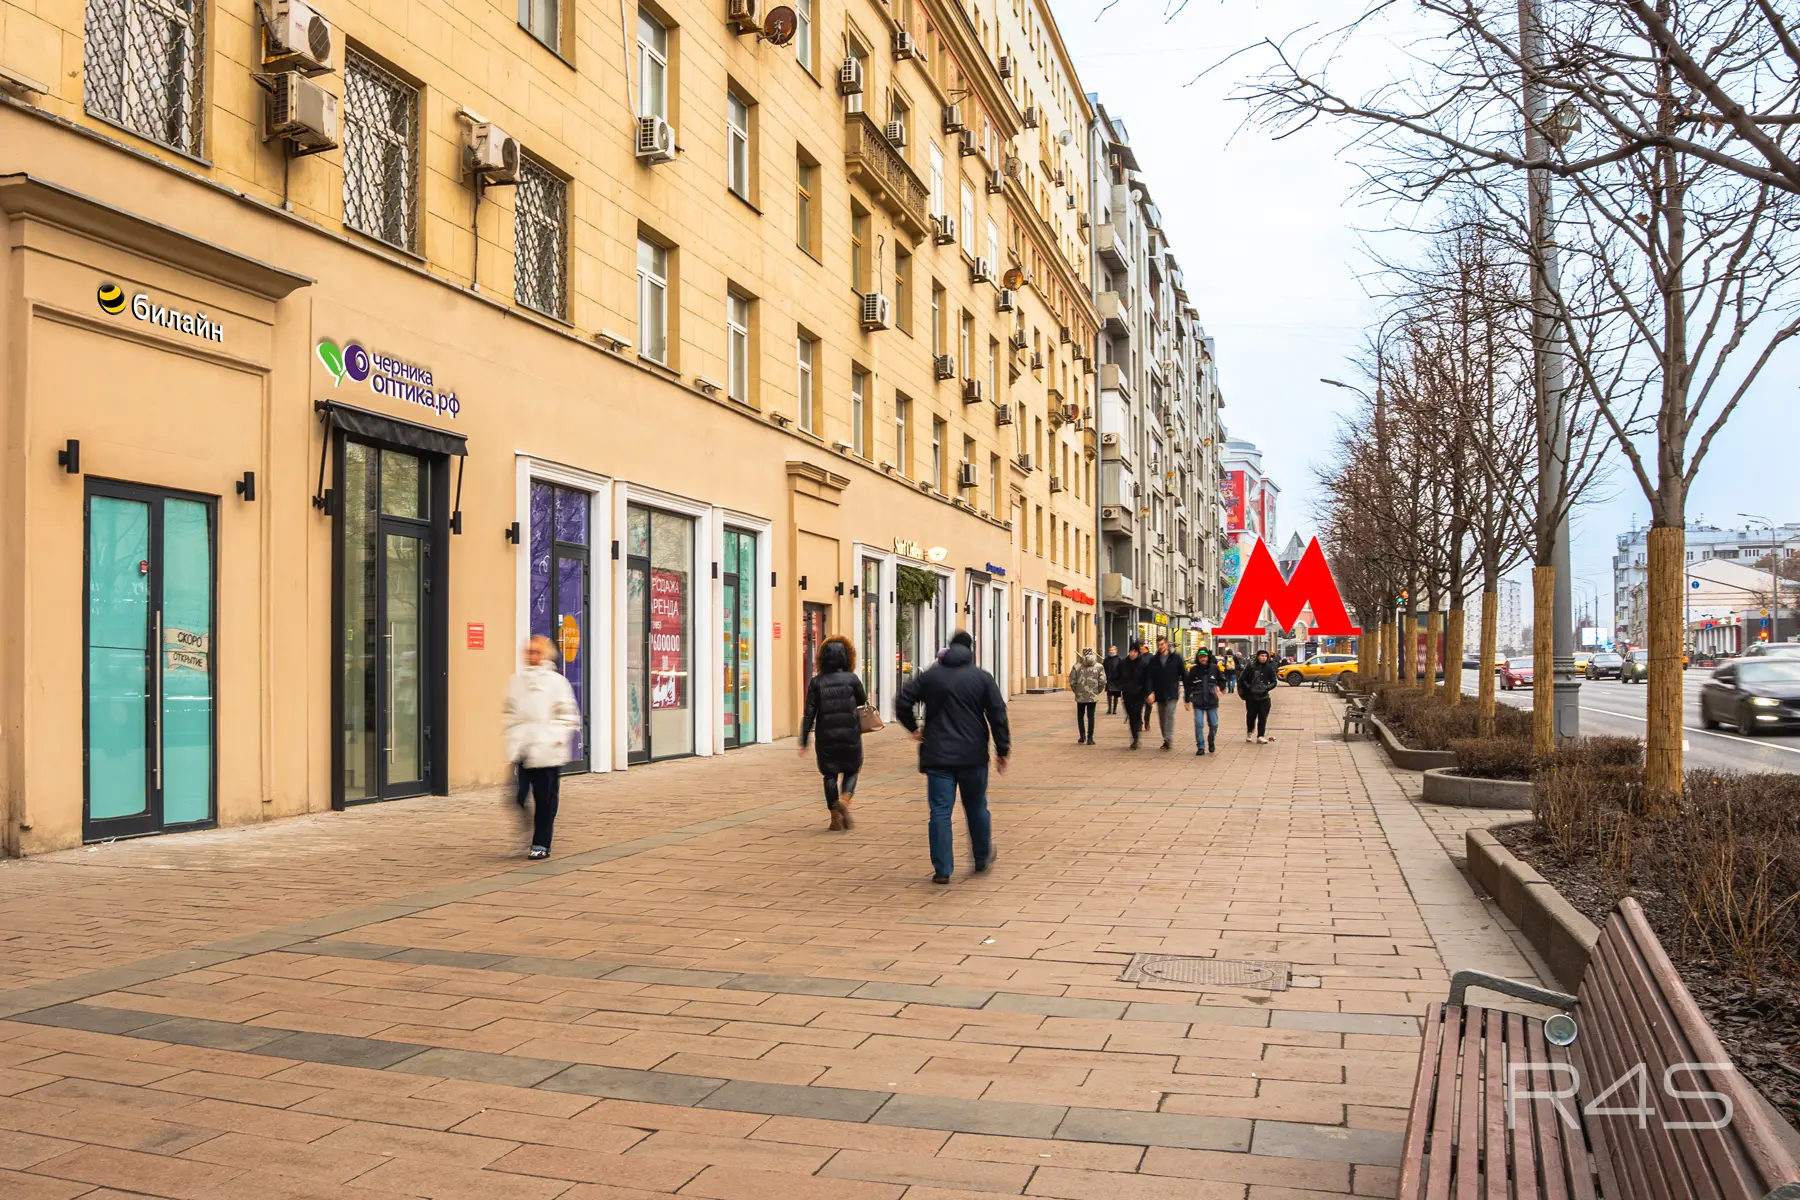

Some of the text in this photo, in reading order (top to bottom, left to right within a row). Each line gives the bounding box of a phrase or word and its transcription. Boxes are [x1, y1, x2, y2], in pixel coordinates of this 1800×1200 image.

[131, 294, 223, 342] билайн
[371, 353, 433, 386] черника
[652, 578, 679, 594] РОДАЖА
[177, 632, 203, 647] СКОРО
[173, 652, 203, 667] ОТКРЫТИЕ
